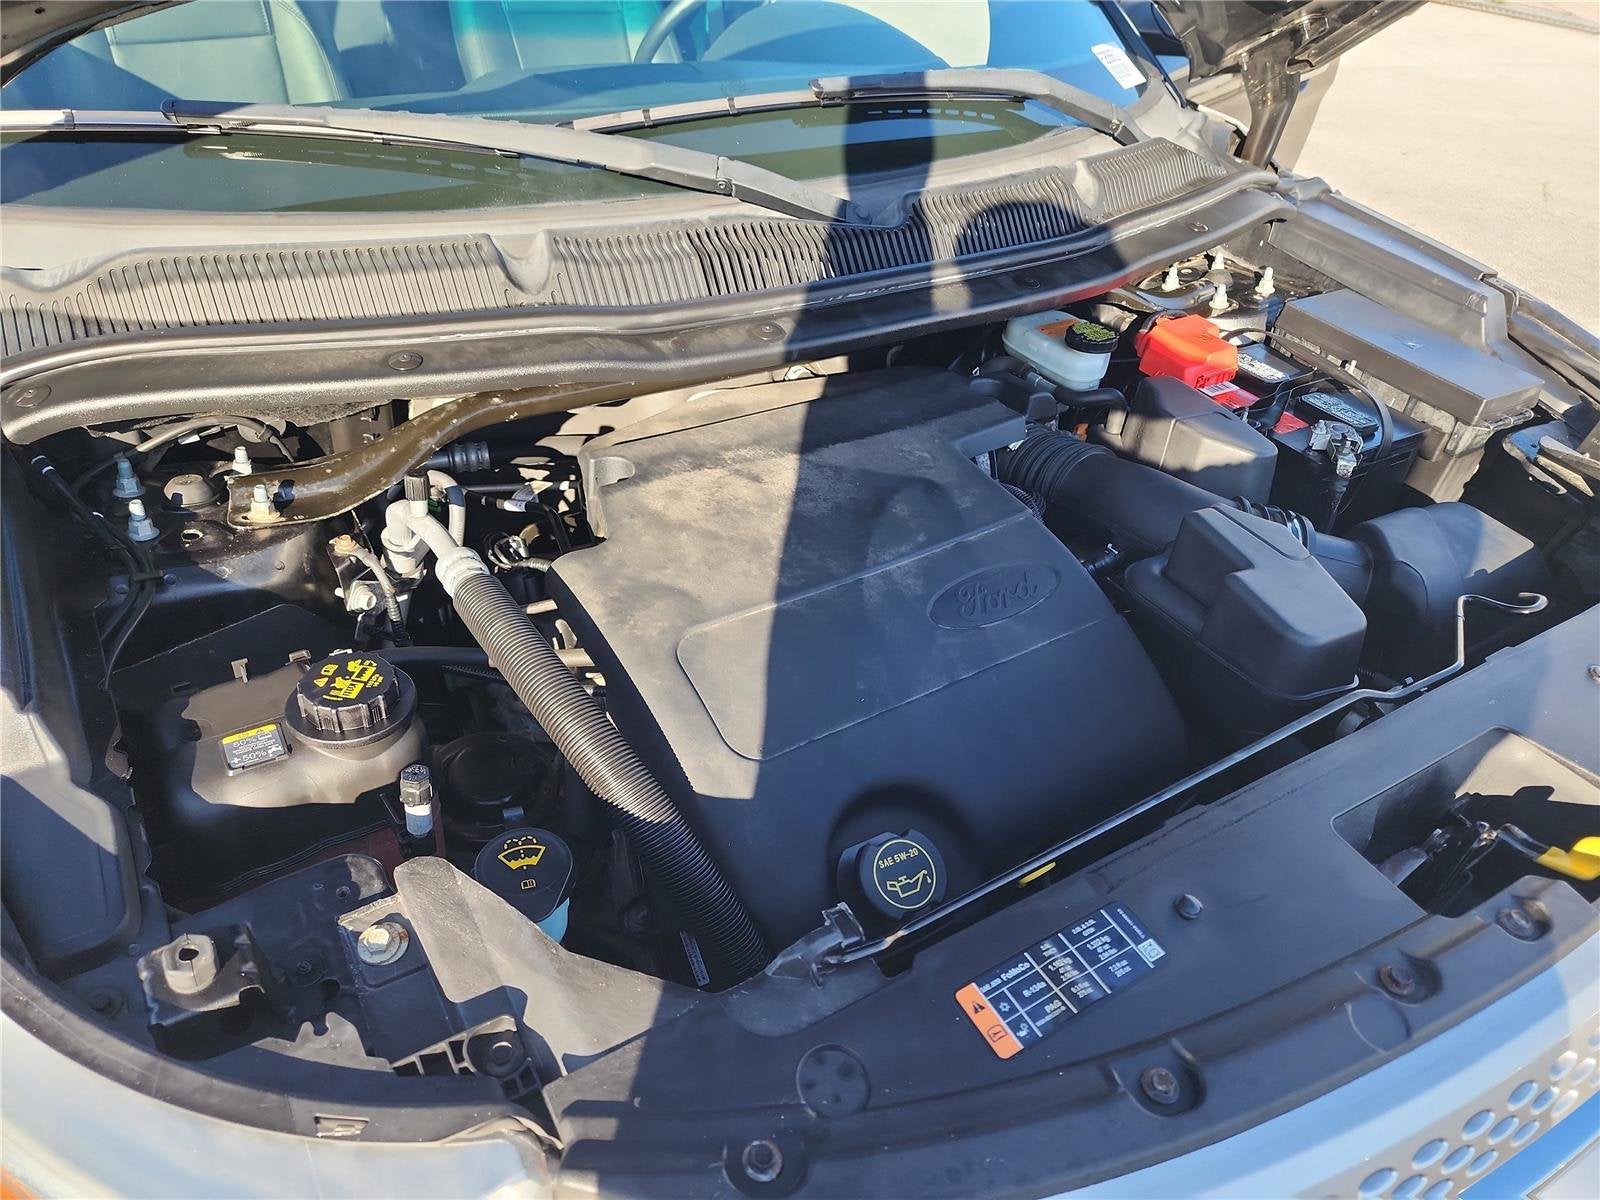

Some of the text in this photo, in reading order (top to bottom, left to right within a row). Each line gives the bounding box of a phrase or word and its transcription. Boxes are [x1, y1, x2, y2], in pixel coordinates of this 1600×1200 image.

[955, 567, 1038, 622] Ford
[879, 847, 919, 869] SAE 5W-20
[1000, 962, 1031, 982] FoMoCo
[1022, 981, 1047, 998] R-134a
